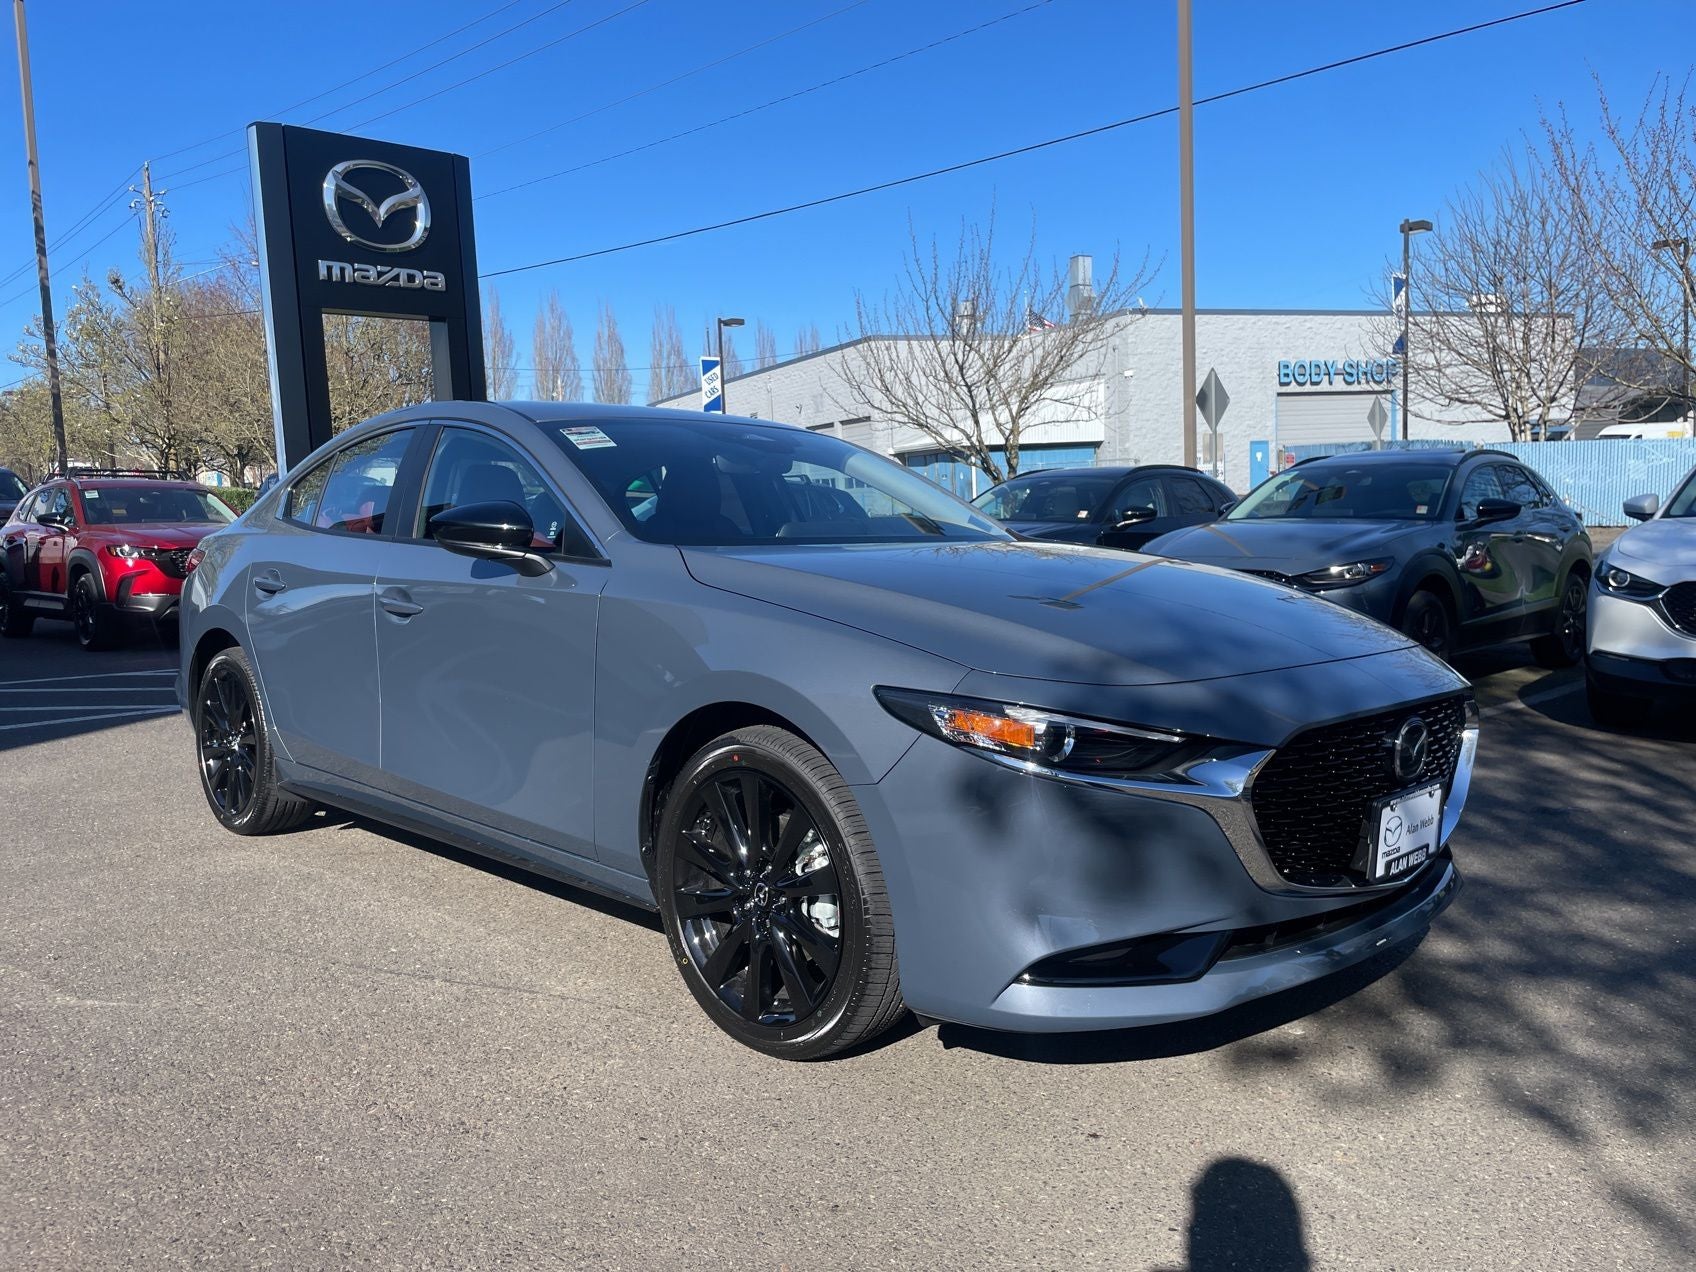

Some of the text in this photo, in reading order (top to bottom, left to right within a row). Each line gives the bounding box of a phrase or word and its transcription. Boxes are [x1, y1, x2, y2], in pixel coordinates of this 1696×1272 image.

[318, 259, 446, 291] mazda
[705, 372, 719, 385] USED
[1278, 358, 1399, 386] BODY SHOP
[705, 386, 719, 398] CARS
[1406, 815, 1434, 836] Alan Webb
[1389, 848, 1427, 876] ALAN WEBB
